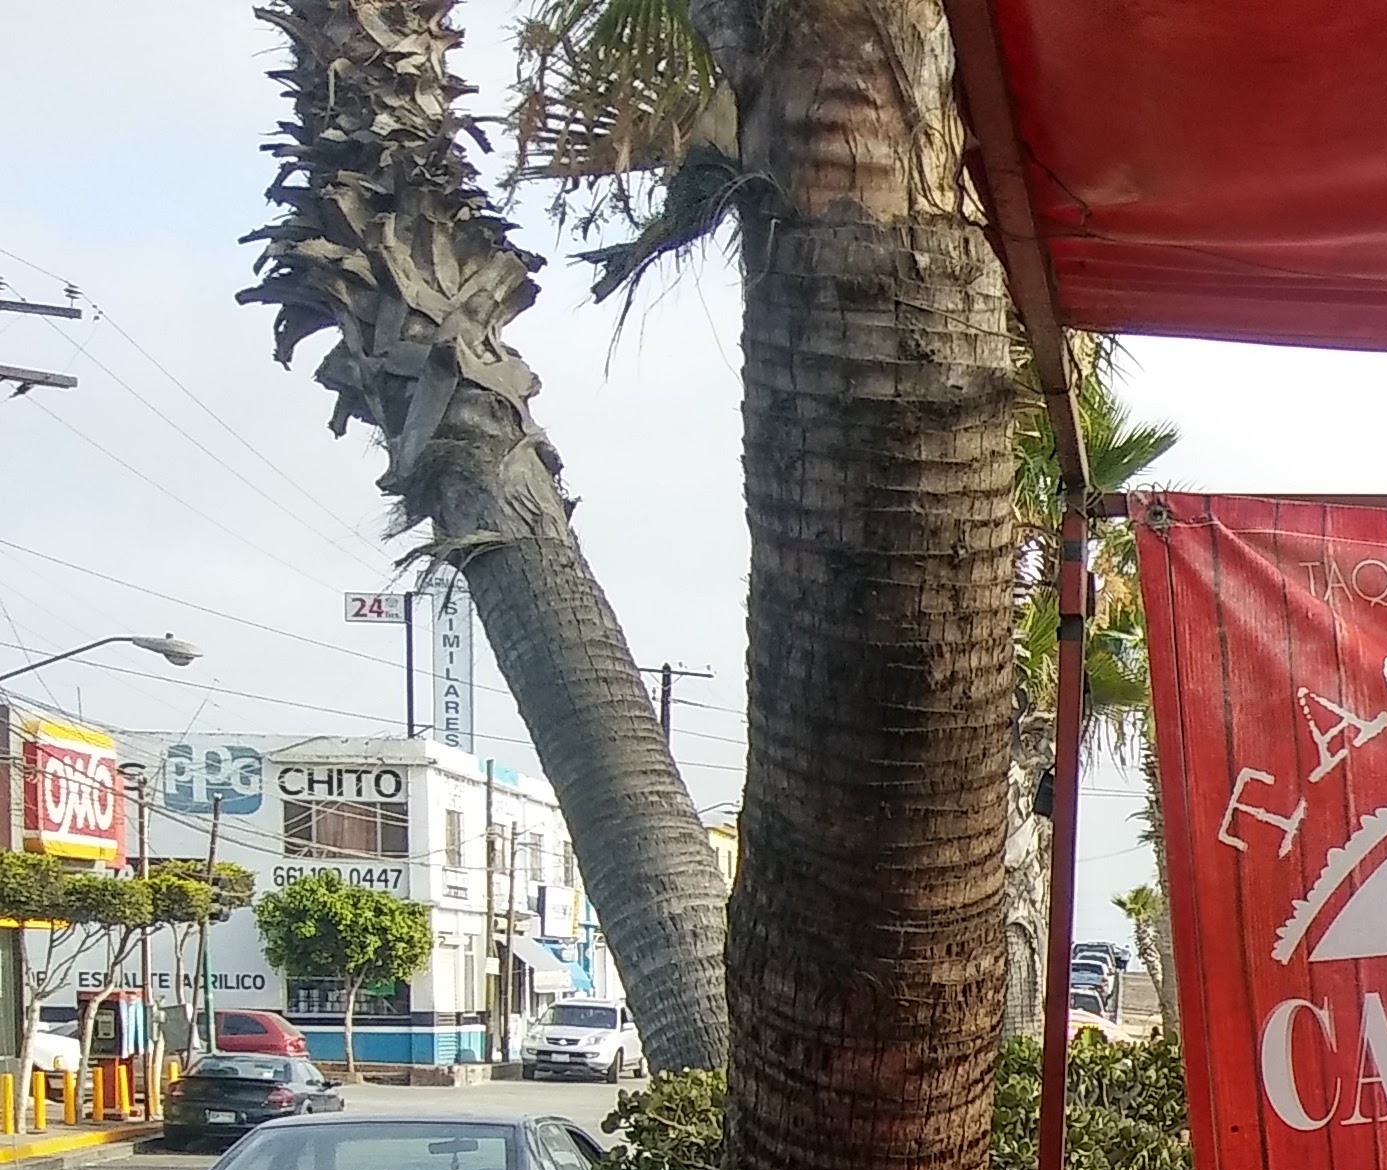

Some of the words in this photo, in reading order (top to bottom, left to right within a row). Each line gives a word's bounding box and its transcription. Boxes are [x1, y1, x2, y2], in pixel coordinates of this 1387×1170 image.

[351, 596, 384, 618] 24
[442, 602, 460, 748] SIMILARES
[277, 767, 403, 799] CHITO
